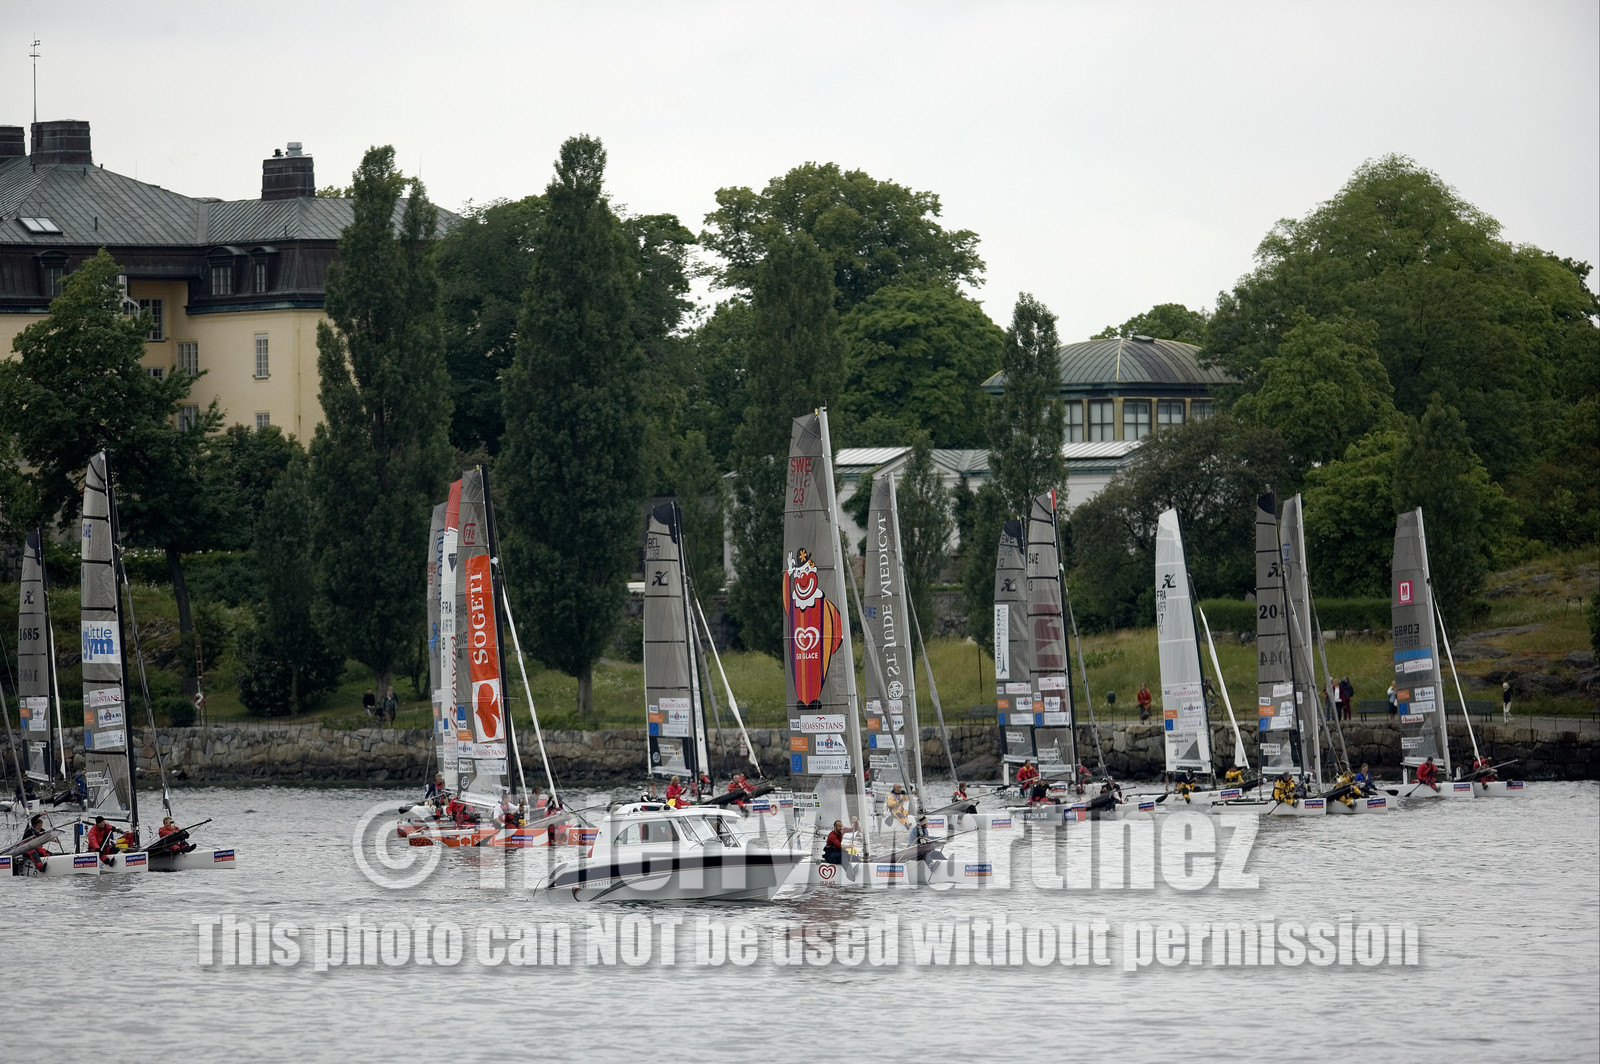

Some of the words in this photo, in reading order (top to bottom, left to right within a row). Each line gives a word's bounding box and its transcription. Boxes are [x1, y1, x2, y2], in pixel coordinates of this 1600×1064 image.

[790, 457, 812, 473] SWE
[793, 487, 804, 503] 23
[1028, 553, 1039, 564] SWE
[1156, 590, 1166, 601] FRA
[442, 601, 452, 614] FRA
[470, 571, 489, 665] SOGETI
[19, 627, 40, 641] 1685
[1395, 624, 1420, 636] GBR03
[83, 631, 114, 660] gym
